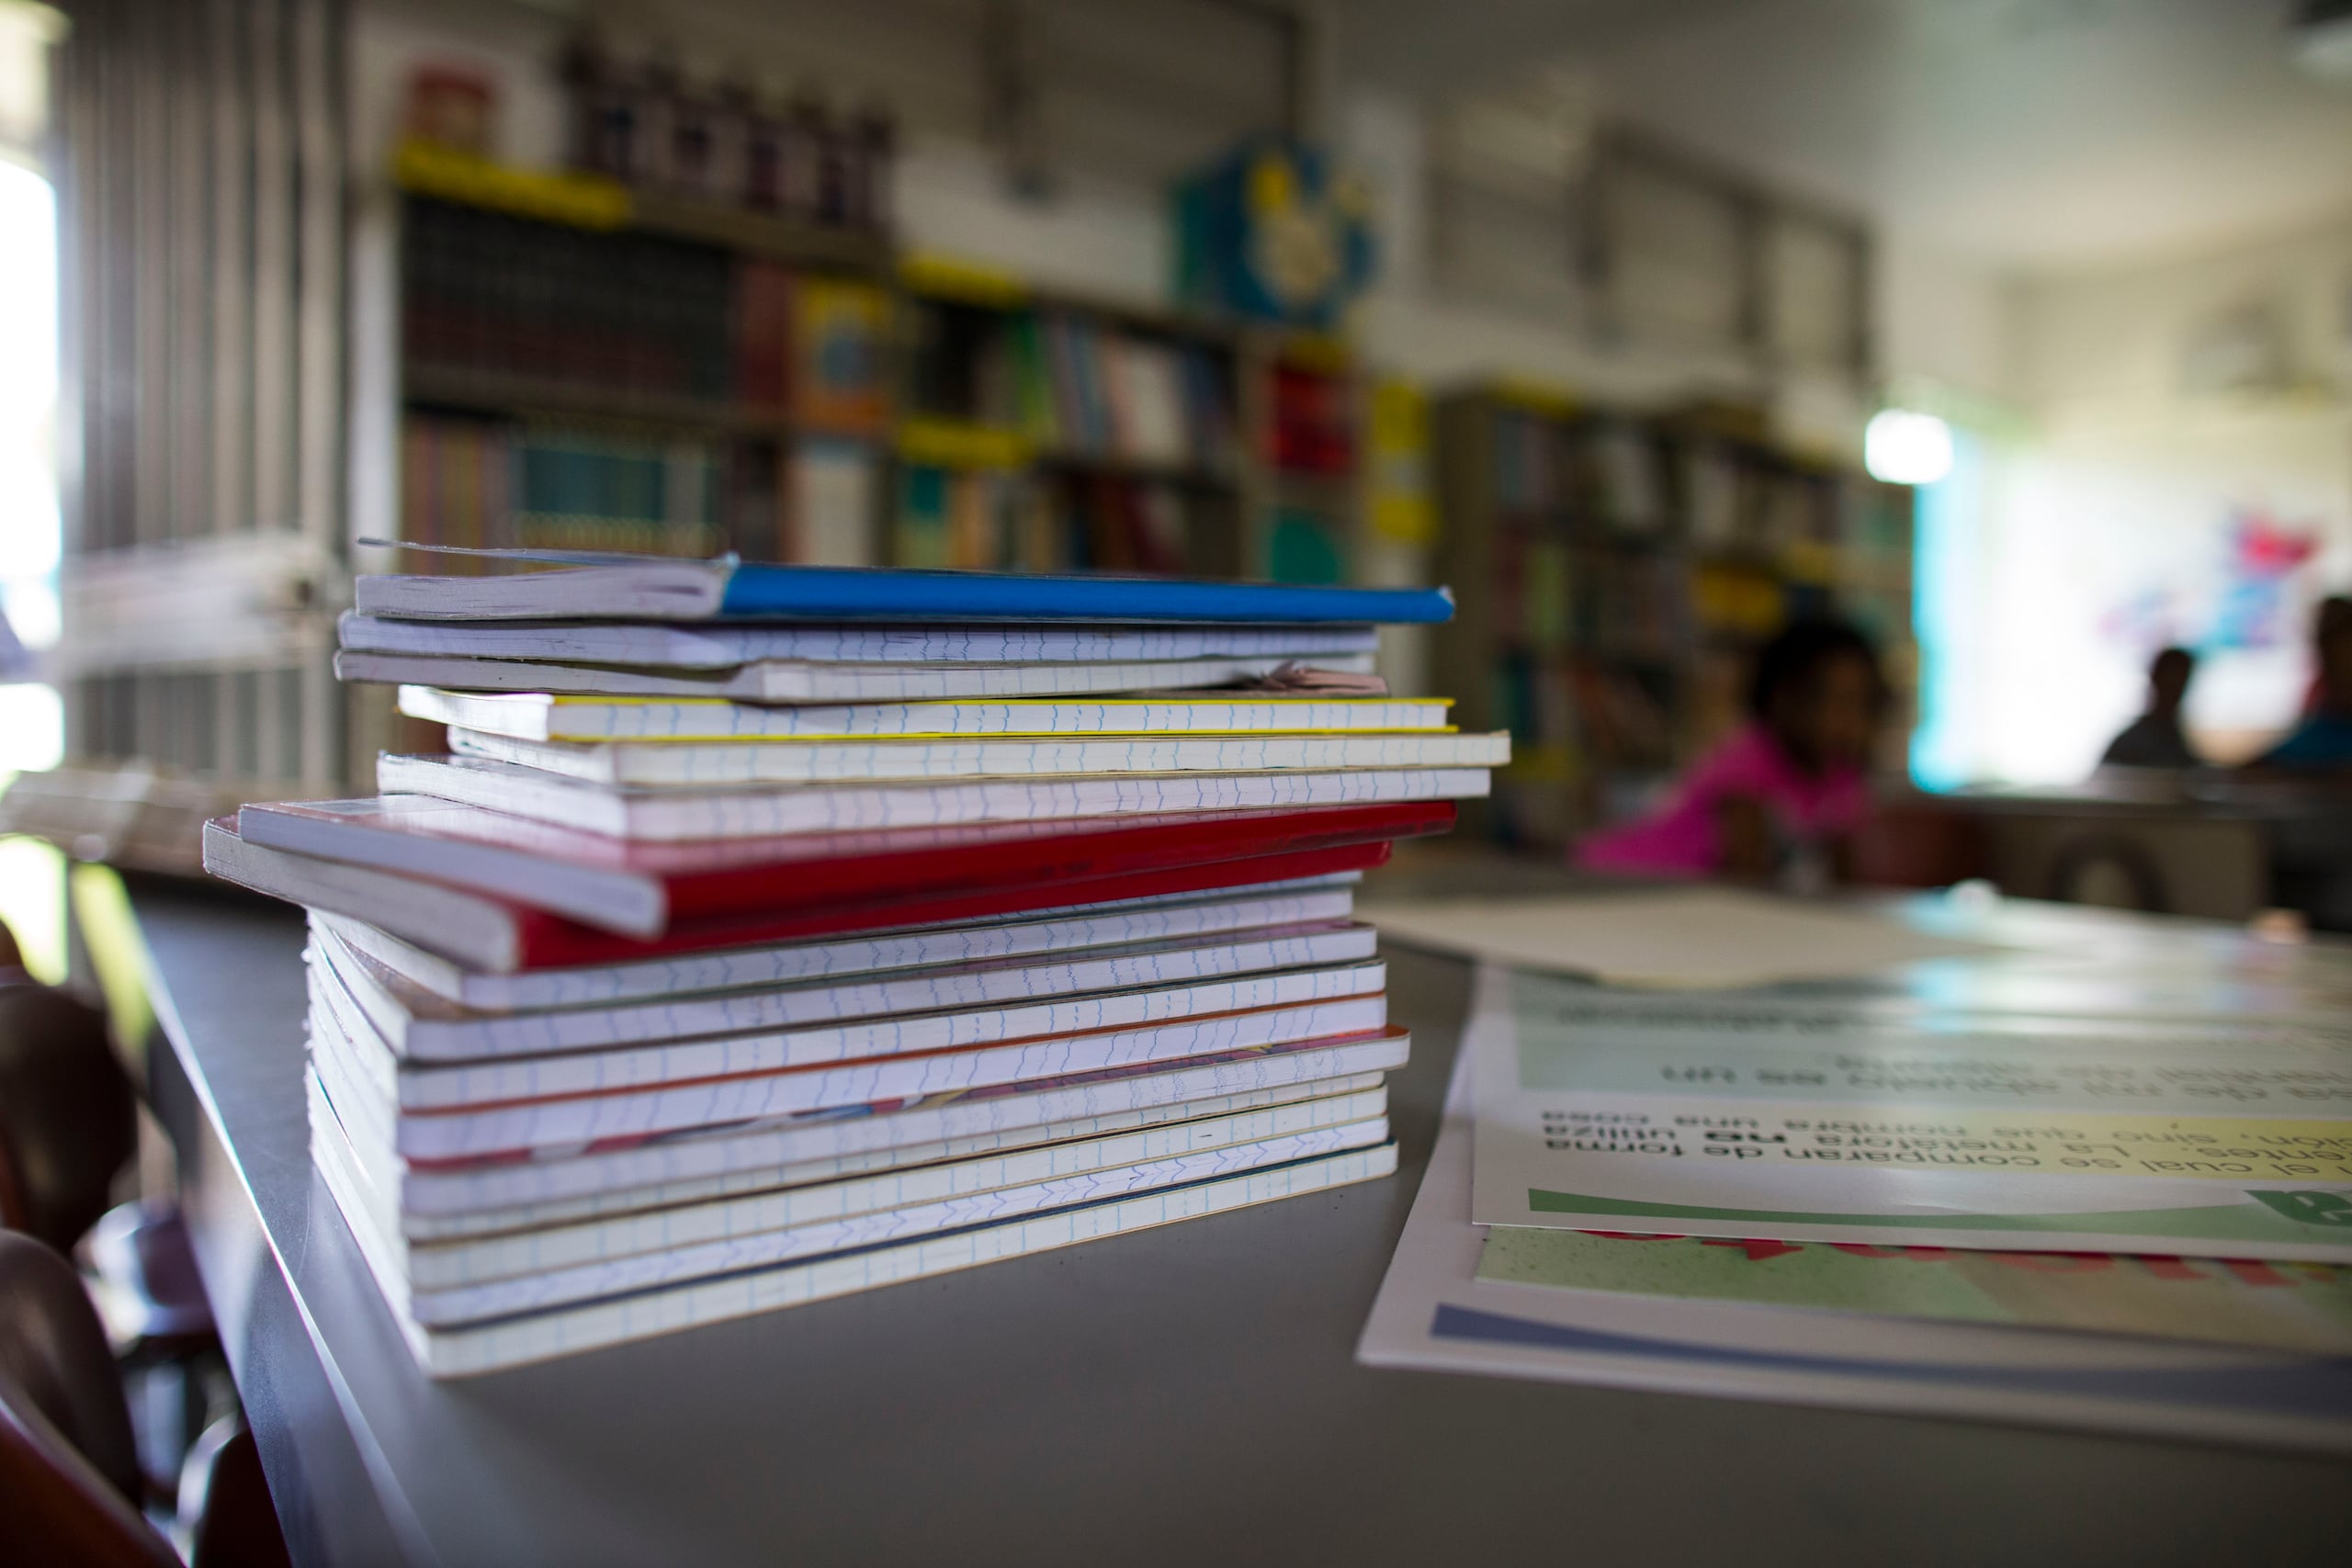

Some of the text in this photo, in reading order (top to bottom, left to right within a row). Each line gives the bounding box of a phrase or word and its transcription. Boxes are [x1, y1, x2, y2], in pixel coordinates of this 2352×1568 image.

[1660, 1064, 1737, 1086] un
[2183, 1085, 2267, 1101] de
[1541, 1111, 1650, 1125] cosa
[1673, 1115, 1759, 1129] una
[1543, 1124, 1676, 1141] utiliza
[1784, 1118, 1968, 1137] nombra
[1992, 1126, 2085, 1141] que
[1702, 1130, 1787, 1145] no
[1815, 1134, 2037, 1155] metáfora
[2112, 1131, 2218, 1145] sino
[1544, 1138, 2319, 1176] el cual se comparan de forma
[2063, 1144, 2130, 1157] La
